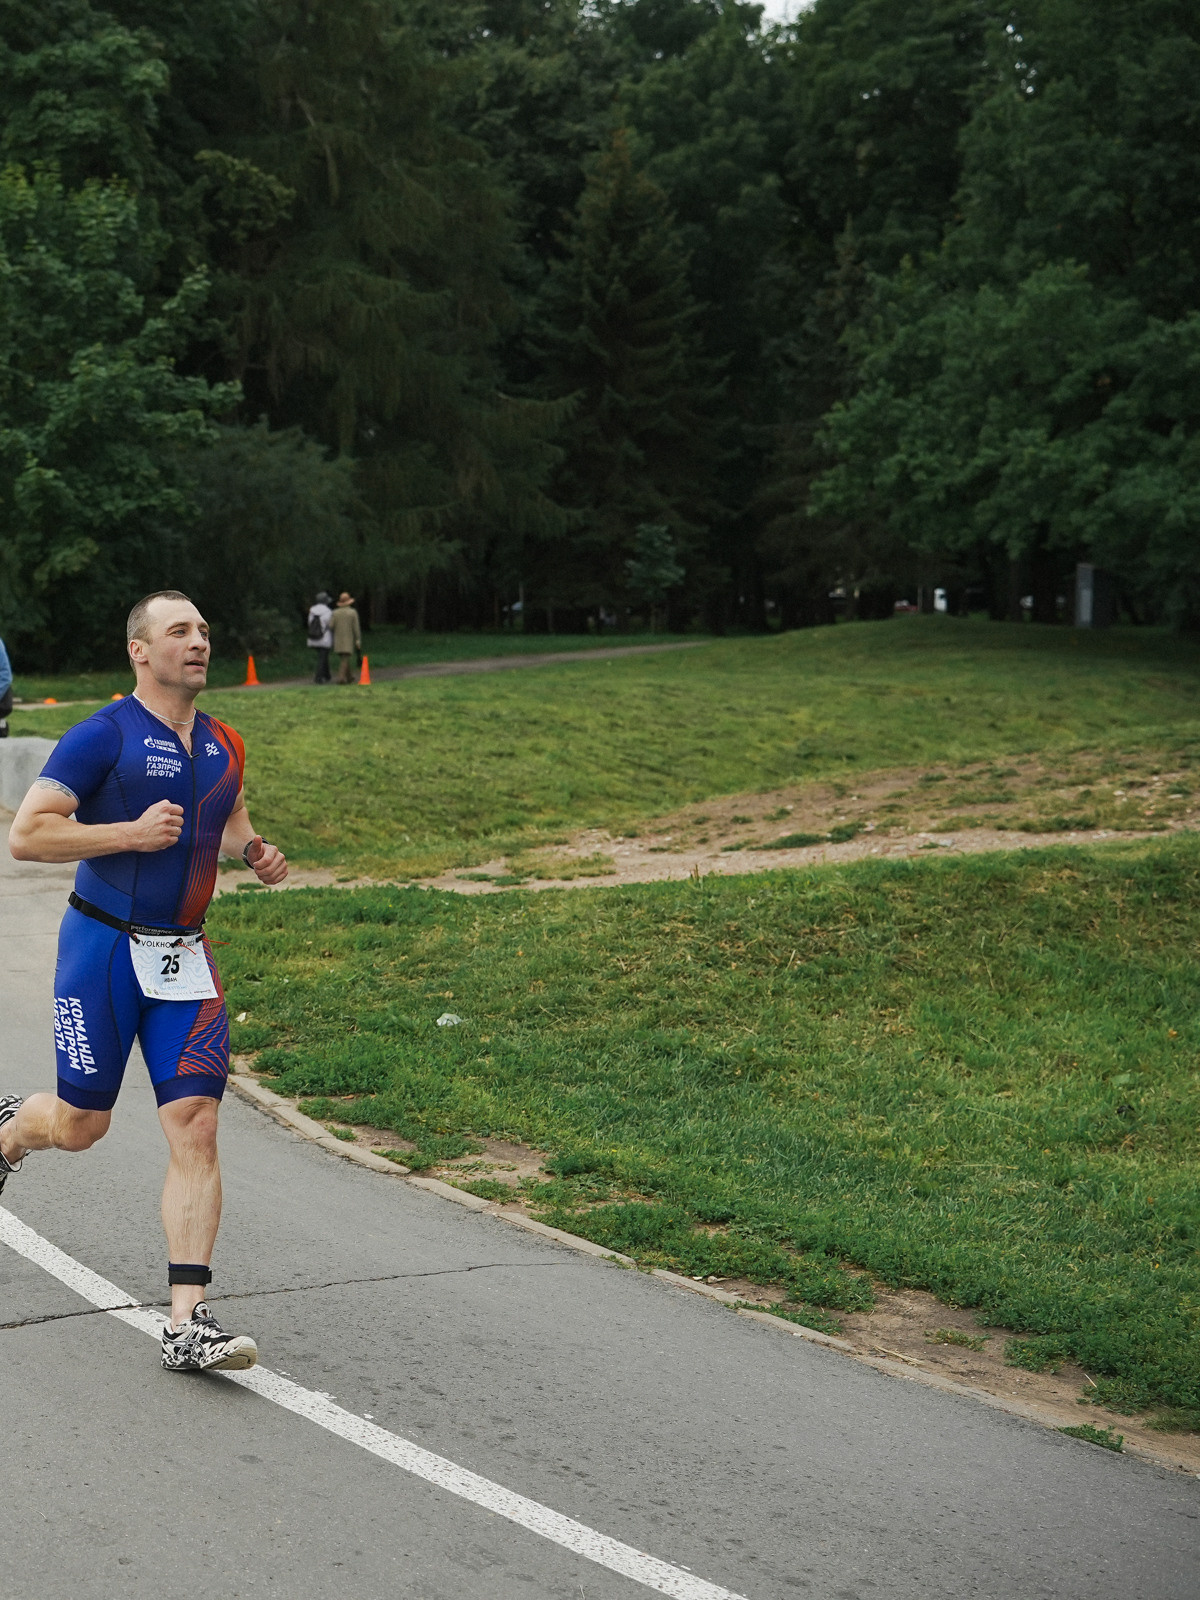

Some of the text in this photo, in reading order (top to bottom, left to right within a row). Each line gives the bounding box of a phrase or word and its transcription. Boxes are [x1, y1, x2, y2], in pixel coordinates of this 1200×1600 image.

[146, 756, 182, 767] КОМАНДА
[146, 763, 181, 773] ГАЗПРОМ
[146, 769, 175, 778] НЕФТИ
[160, 954, 180, 975] 25
[54, 997, 67, 1052] НЕФТИ
[58, 997, 81, 1070] ГАЗПРОМ
[68, 997, 98, 1074] КОМАНДА
